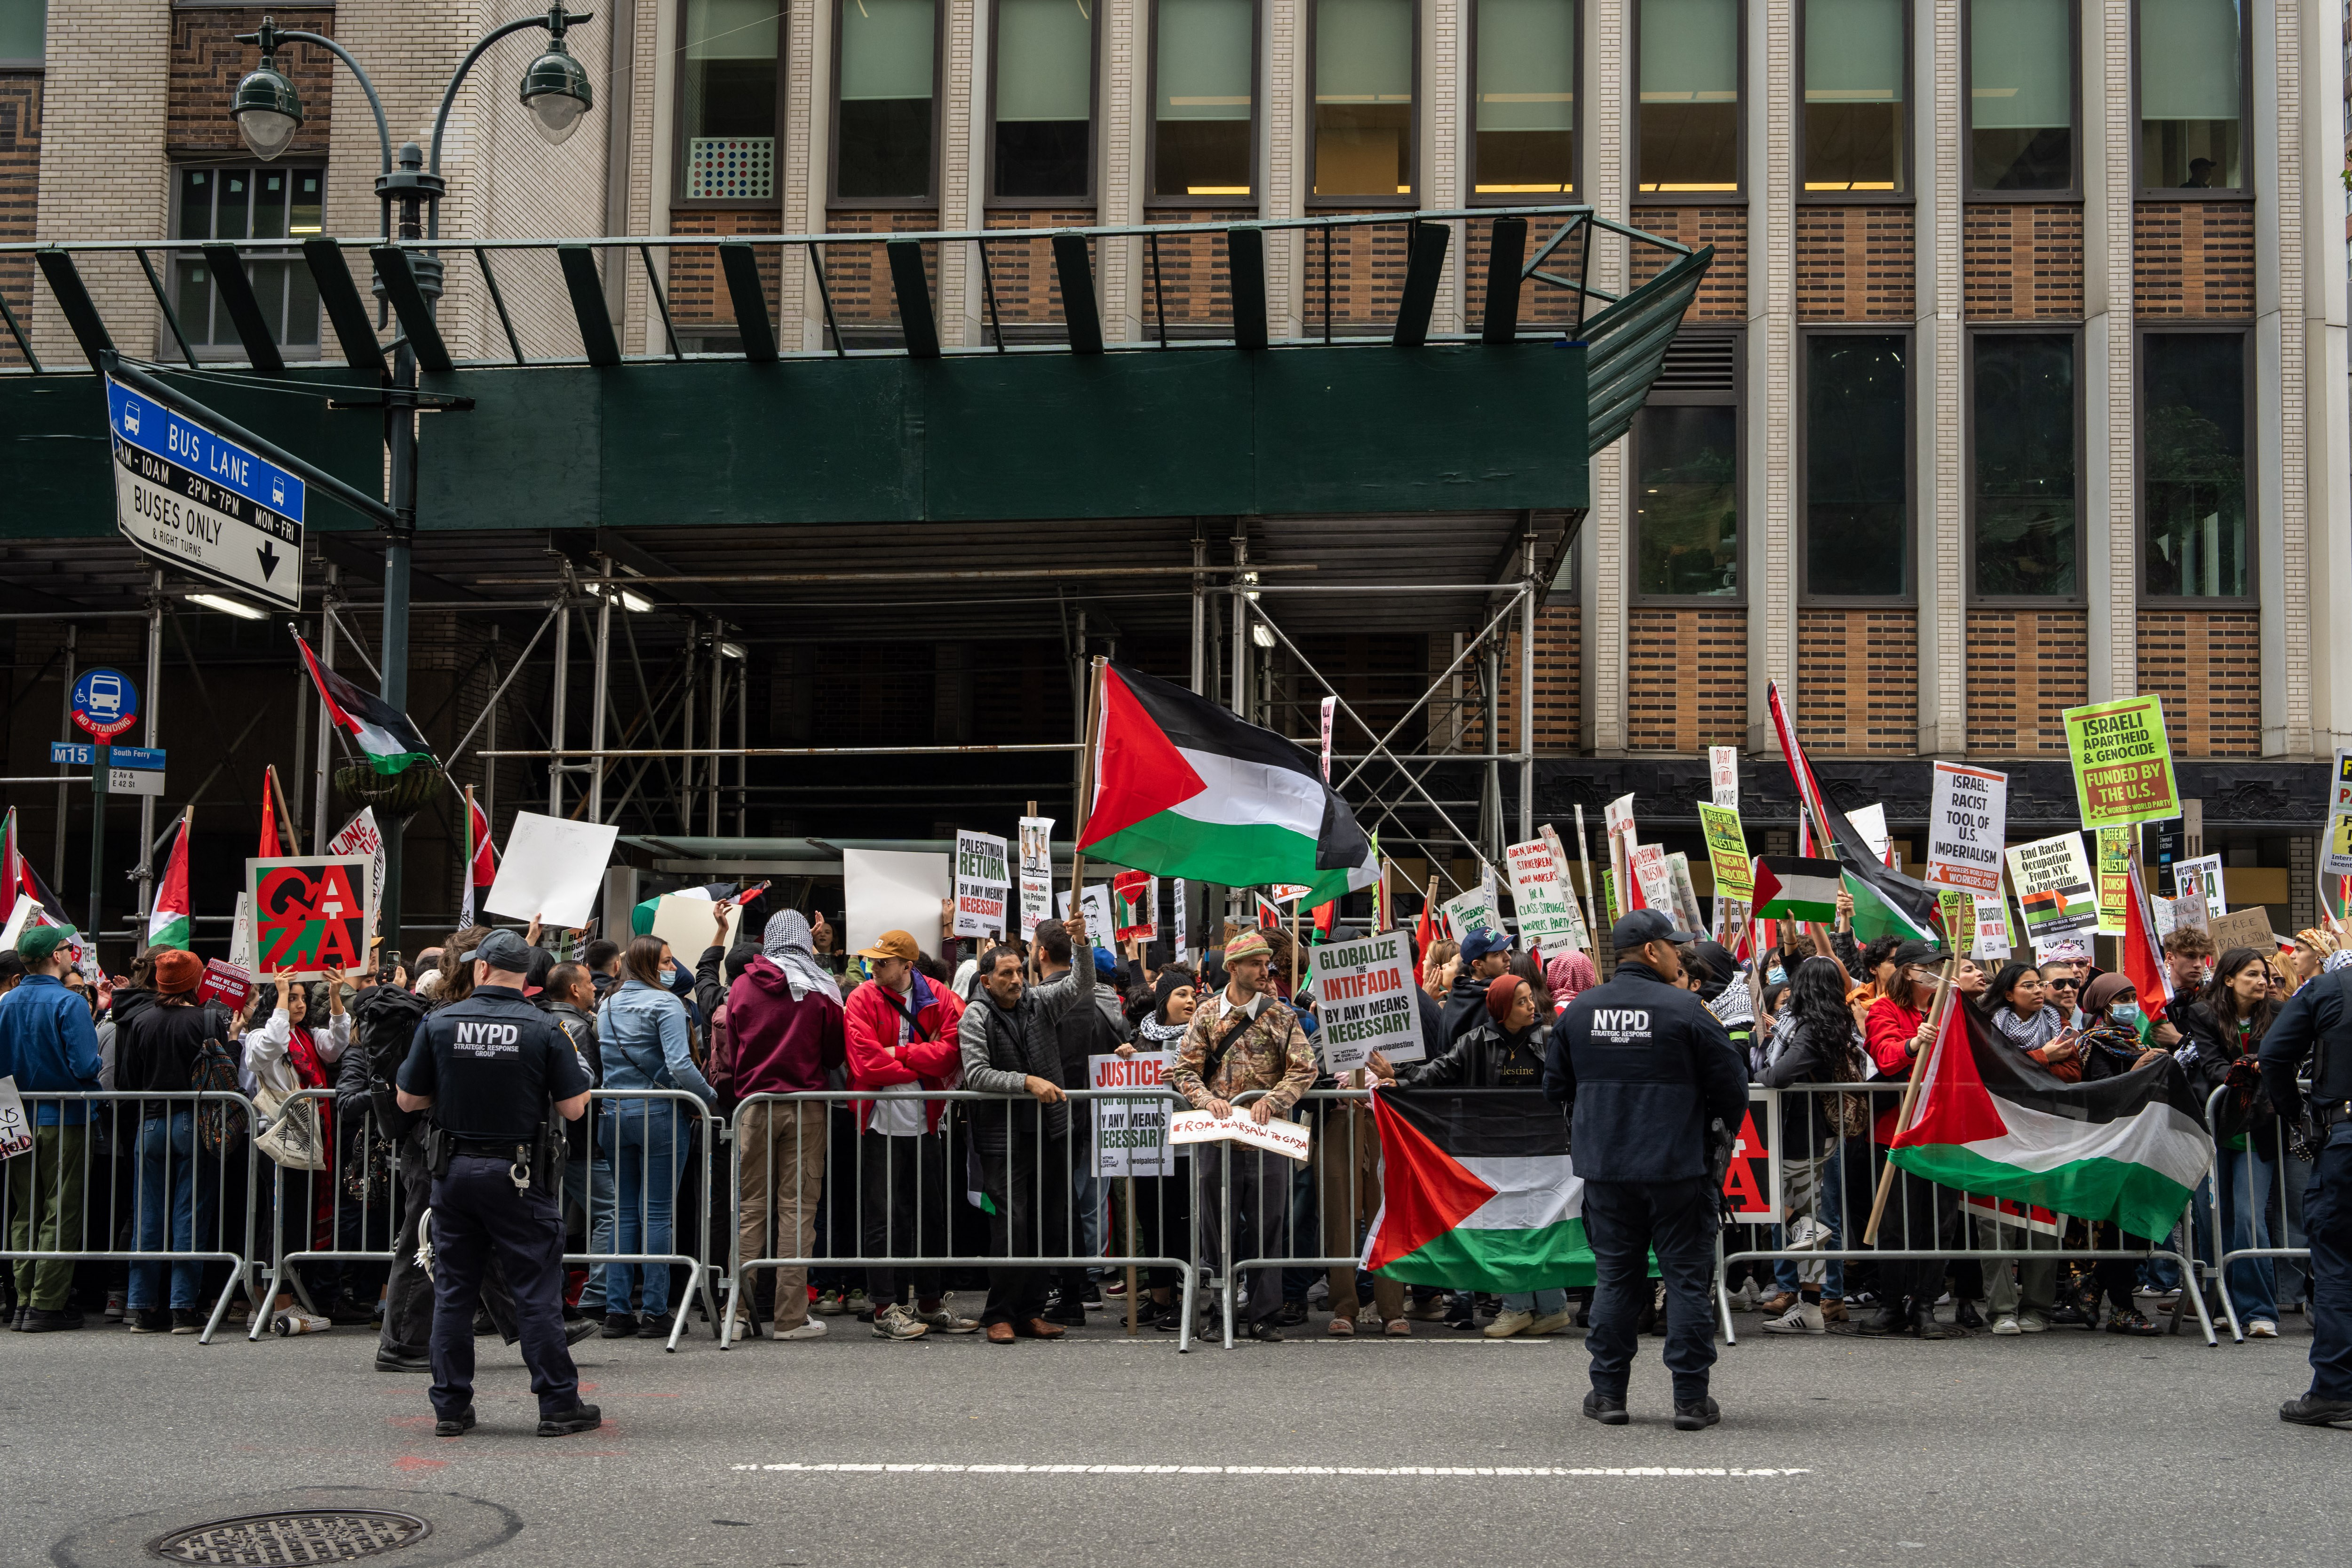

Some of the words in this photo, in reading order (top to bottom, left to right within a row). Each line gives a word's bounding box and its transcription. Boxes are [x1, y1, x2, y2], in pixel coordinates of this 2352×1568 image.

[169, 423, 199, 462] BUS
[211, 445, 249, 487] LANE
[117, 439, 131, 467] 7AM
[142, 455, 169, 484] 10AM
[188, 477, 209, 502] 2PM
[219, 491, 239, 516] 7PM
[255, 508, 273, 532] MON
[282, 523, 294, 541] FRI
[135, 485, 180, 529] BUSES
[186, 509, 222, 546] ONLY
[153, 528, 157, 540] &
[160, 531, 178, 548] RIGHT
[181, 539, 201, 557] TURNS
[205, 562, 221, 571] TRANSPORTATION
[77, 714, 88, 725] NO
[90, 717, 131, 733] STANDING
[2082, 712, 2143, 737] ISRAELI
[2084, 729, 2149, 750] APARTHEID
[134, 750, 150, 759] Ferry
[2084, 753, 2094, 764] &
[2097, 742, 2155, 762] GENOCIDE
[1952, 774, 1988, 793] ISRAEL:
[2086, 767, 2138, 787] FUNDED
[2140, 763, 2161, 779] BY
[2098, 786, 2124, 803] THE
[2126, 782, 2156, 799] U.S.
[1952, 793, 1987, 811] RACIST
[2107, 805, 2131, 814] WORKERS
[2133, 802, 2152, 811] WORLD
[2153, 799, 2171, 808] PARTY
[1622, 818, 1634, 832] ACTION
[1707, 810, 1732, 825] DEFEND
[1947, 811, 1975, 827] TOOL
[1978, 816, 1989, 829] OF
[332, 818, 367, 855] LONG
[1959, 827, 1978, 842] U.S.
[2104, 827, 2130, 841] DEFEND
[960, 838, 1003, 859] PALESTINIAN
[1708, 835, 1744, 852] PALESTINE!
[2020, 849, 2037, 860] End
[2038, 840, 2067, 858] Racist
[1509, 847, 1526, 859] BIDEN,
[1639, 847, 1657, 864] DEFEND
[1715, 853, 1739, 867] ZIONISM
[1740, 860, 1745, 868] IS
[1935, 841, 1996, 864] IMPERIALISM
[960, 852, 1006, 881] RETURN
[2022, 852, 2072, 871] Occupation
[2203, 860, 2217, 871] WITH
[1519, 874, 1532, 884] WAR
[1533, 871, 1558, 882] MAKERS
[1719, 867, 1748, 882] GENOCIDE!
[1946, 865, 1969, 874] WORKERS
[1983, 870, 1997, 879] PARTY
[2028, 870, 2051, 882] From
[2052, 863, 2070, 877] NYC
[1949, 873, 1996, 889] WORKERS.ORG
[2026, 883, 2035, 894] to
[2037, 875, 2079, 892] Palestine
[2104, 878, 2126, 890] ZIONISM
[960, 883, 968, 895] BY
[971, 885, 983, 897] ANY
[985, 887, 1002, 901] MEANS
[1031, 893, 1046, 902] Prison
[1528, 888, 1538, 900] FOR
[1540, 887, 1544, 898] A
[960, 896, 1002, 917] NECESSARY
[1026, 901, 1040, 912] Regime
[1451, 901, 1463, 916] FULL
[1519, 901, 1566, 915] CLASS-STRUGGL
[1946, 908, 1957, 916] END
[2192, 898, 2200, 910] is
[1465, 917, 1486, 933] RIGHTS
[1522, 919, 1548, 931] WORKERS
[1550, 917, 1569, 930] PARTY
[1980, 923, 1994, 936] UNTIL
[2031, 922, 2047, 931] BRONX
[2069, 913, 2095, 922] COALITION
[2050, 923, 2077, 931] @bxantiwar
[2218, 917, 2257, 934] FREE
[568, 926, 592, 942] BLACK
[2218, 931, 2273, 949] PALESTINE
[561, 934, 596, 953] BROOKLYN
[573, 949, 584, 959] FOR
[1319, 940, 1398, 970] GLOBALIZE
[210, 961, 231, 975] SOCIALIST
[1356, 965, 1367, 974] THE
[205, 979, 226, 991] MARXIST
[227, 987, 245, 997] THEORY
[1323, 967, 1402, 1001] INTIFADA
[1325, 1008, 1339, 1024] BY
[1344, 1004, 1365, 1021] ANY
[1369, 995, 1409, 1016] MEANS
[1327, 1011, 1410, 1044] NECESSARY
[1593, 1010, 1649, 1031] NYPD
[457, 1022, 518, 1044] NYPD
[1373, 1040, 1414, 1052] @wolpalestine
[1096, 1060, 1164, 1087] JUSTICE
[1501, 1066, 1534, 1075] lestine
[1109, 1113, 1124, 1128] ANY
[1131, 1112, 1165, 1127] MEANS
[1173, 1121, 1215, 1132] FROM
[1221, 1121, 1268, 1137] WARSAW
[1282, 1137, 1307, 1150] GAZA
